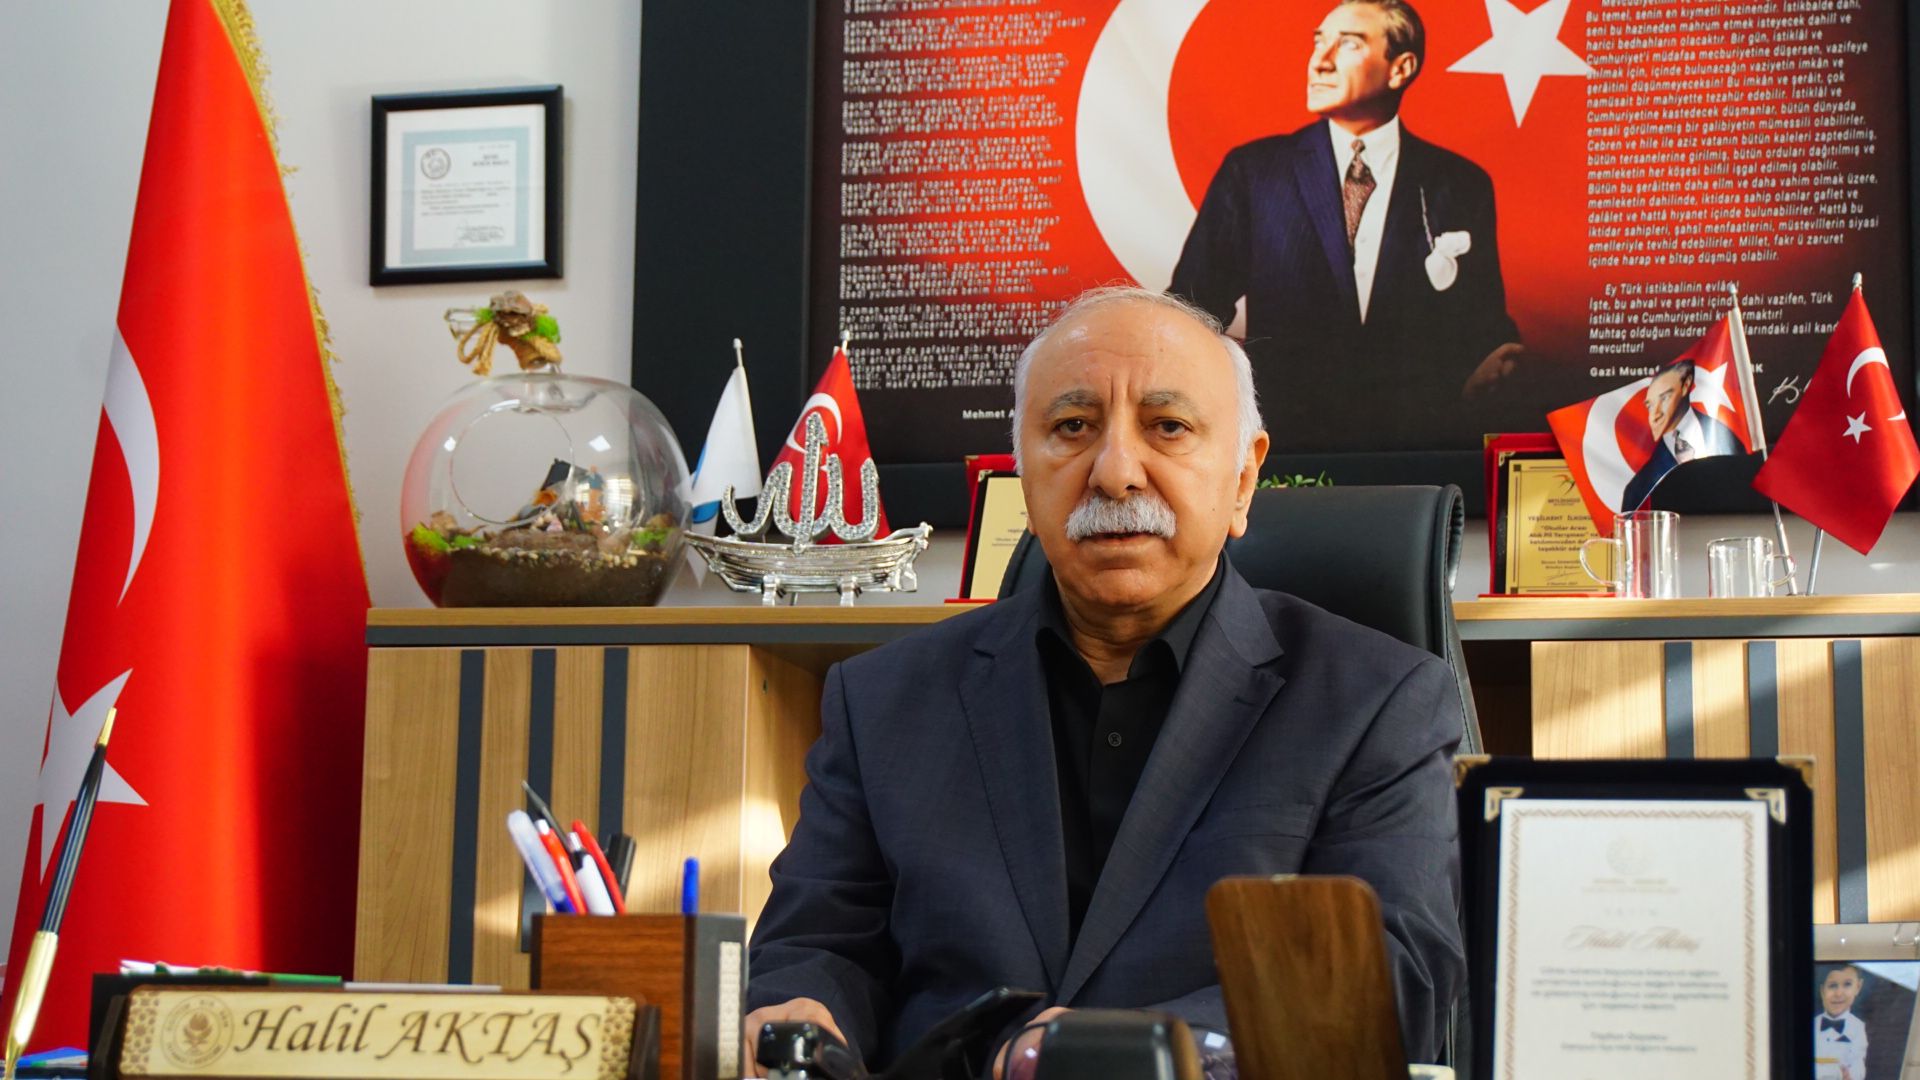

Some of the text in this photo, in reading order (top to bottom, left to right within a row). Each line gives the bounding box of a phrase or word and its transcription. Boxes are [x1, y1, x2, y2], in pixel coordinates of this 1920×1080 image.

[1585, 10, 1600, 22] Bu
[1665, 9, 1678, 18] en
[1609, 23, 1623, 35] bu
[1840, 14, 1851, 23] ve
[1730, 31, 1745, 43] Bir
[1811, 30, 1823, 40] ve
[1832, 58, 1844, 67] ve
[1726, 75, 1740, 87] Bu
[1777, 76, 1788, 84] ve
[1827, 70, 1845, 85] çok
[1635, 93, 1650, 105] bir
[1830, 87, 1842, 96] ve
[1685, 120, 1700, 132] bir
[1624, 140, 1637, 149] ve
[1661, 136, 1674, 147] ile
[1864, 145, 1875, 154] ve
[1648, 165, 1665, 177] her
[1620, 180, 1633, 193] bu
[1737, 179, 1749, 188] ve
[1847, 189, 1858, 199] ve
[1626, 212, 1638, 221] ve
[1850, 201, 1863, 213] bu
[1797, 232, 1804, 244] ü
[1654, 255, 1666, 264] ve
[1605, 282, 1617, 297] Ey
[1614, 297, 1627, 309] bu
[1660, 299, 1672, 307] ve
[1627, 314, 1639, 323] ve
[1619, 364, 1660, 375] Mustaf
[962, 409, 1005, 419] Mehmet
[233, 1003, 387, 1055] Halil
[373, 1004, 603, 1074] AKTAŞ
